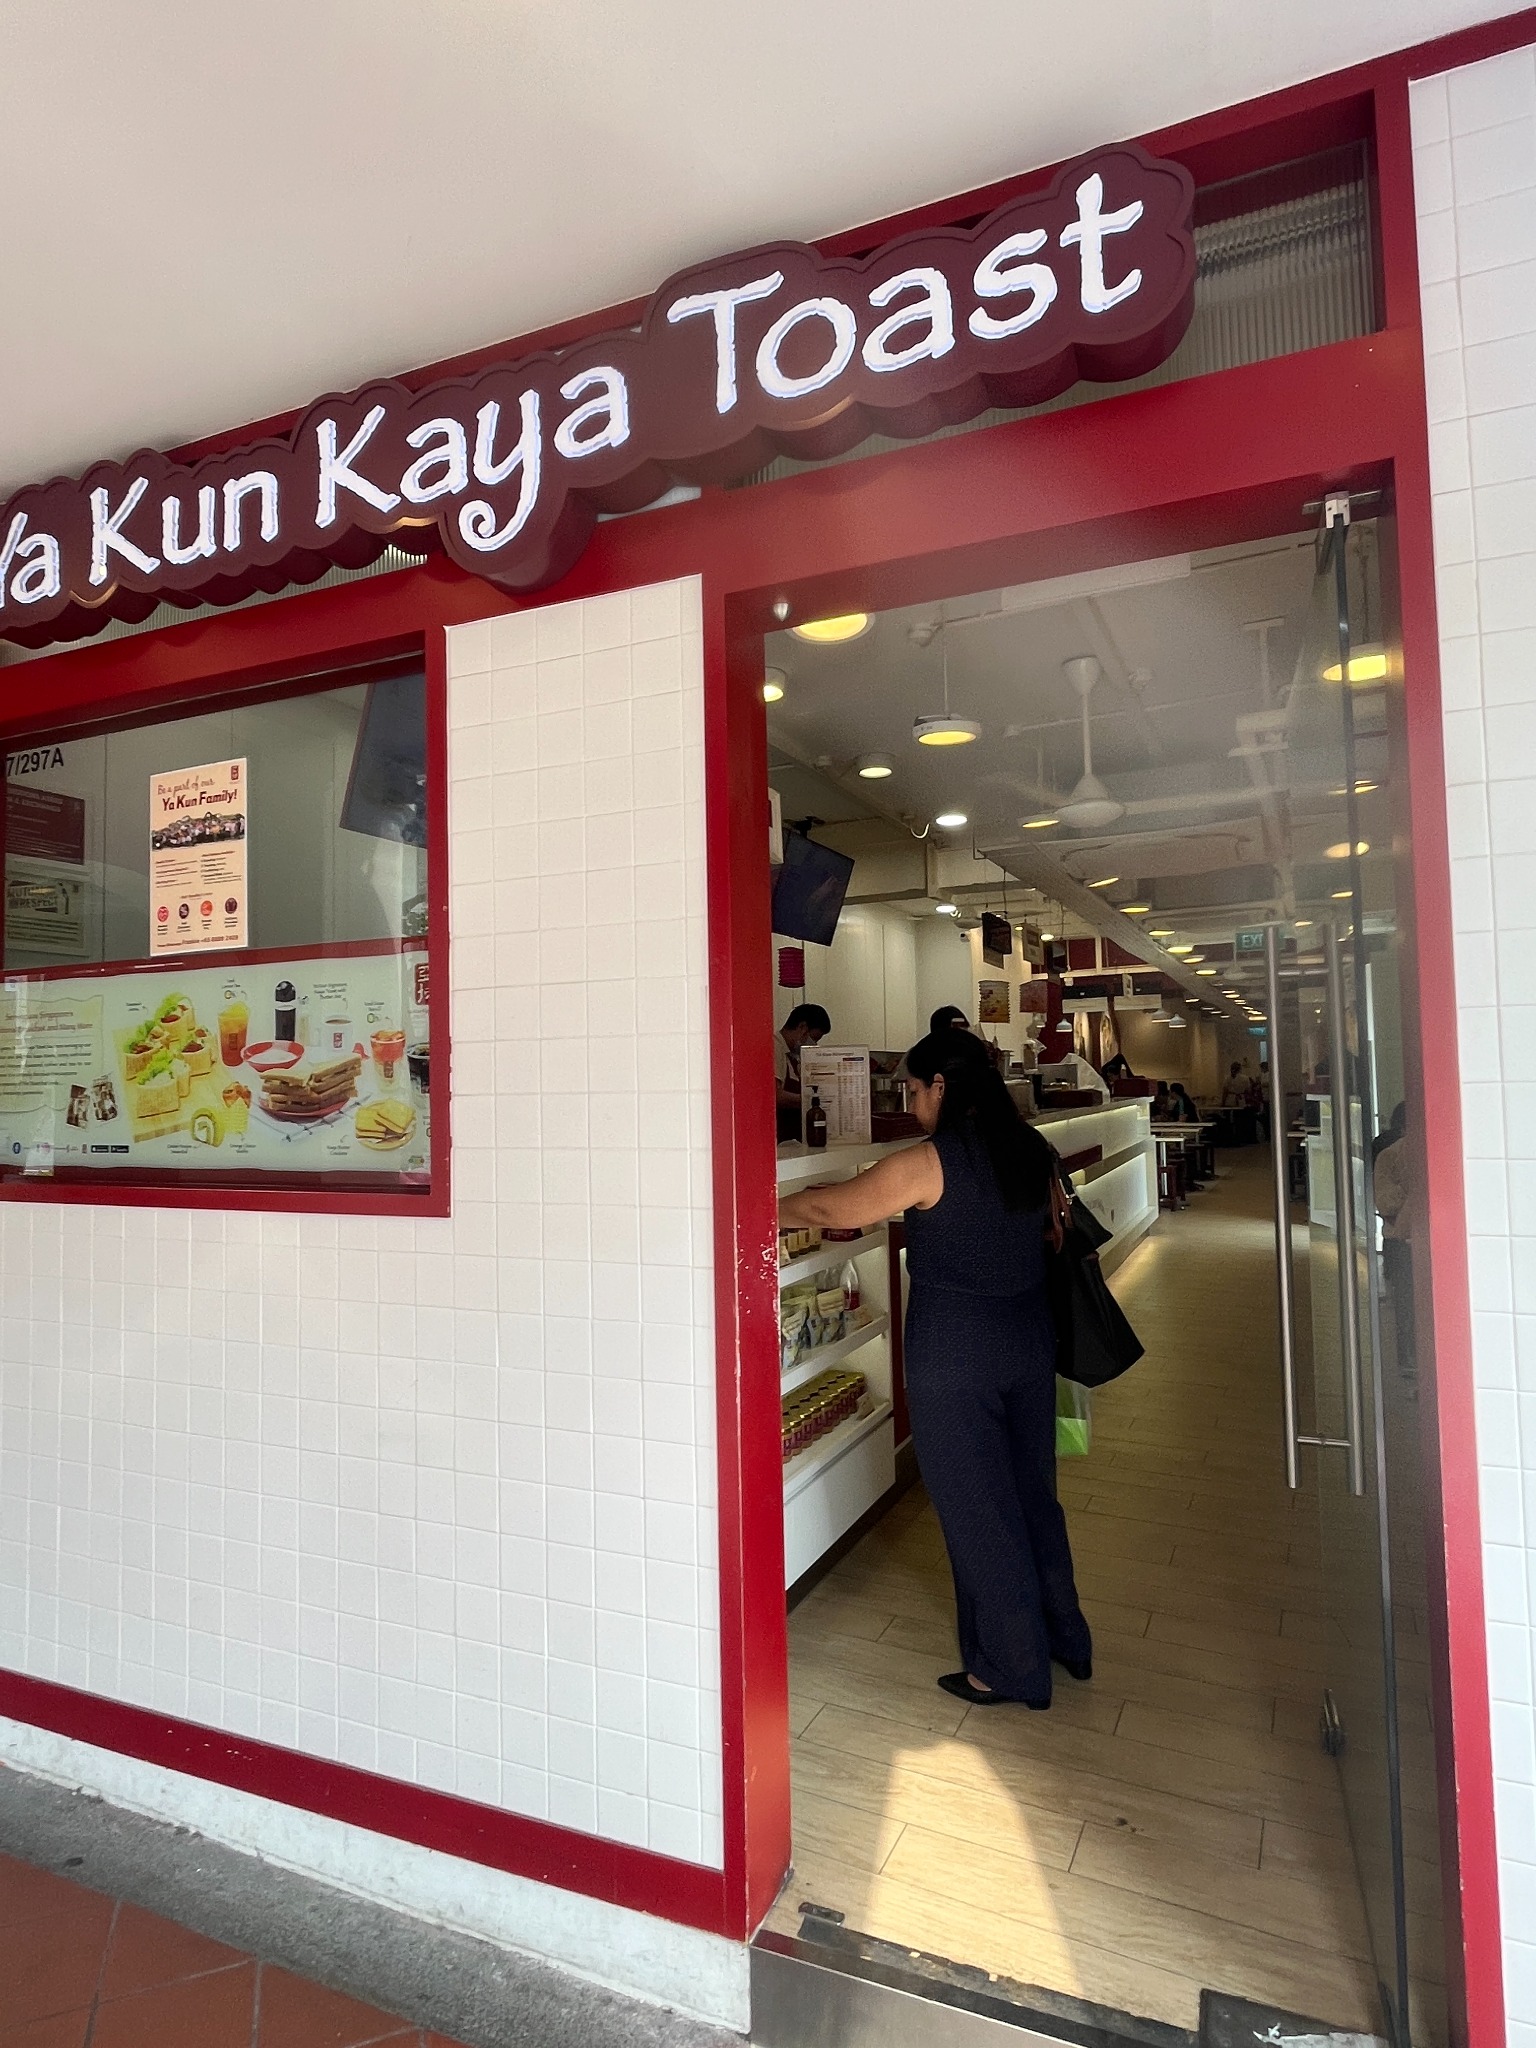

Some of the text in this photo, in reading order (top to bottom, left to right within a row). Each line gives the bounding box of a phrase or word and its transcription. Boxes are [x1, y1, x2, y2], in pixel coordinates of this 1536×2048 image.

[88, 470, 279, 587] Kun
[314, 365, 631, 552] Kaya
[666, 172, 1144, 414] Toast
[162, 788, 238, 811] Ya Kun Family!
